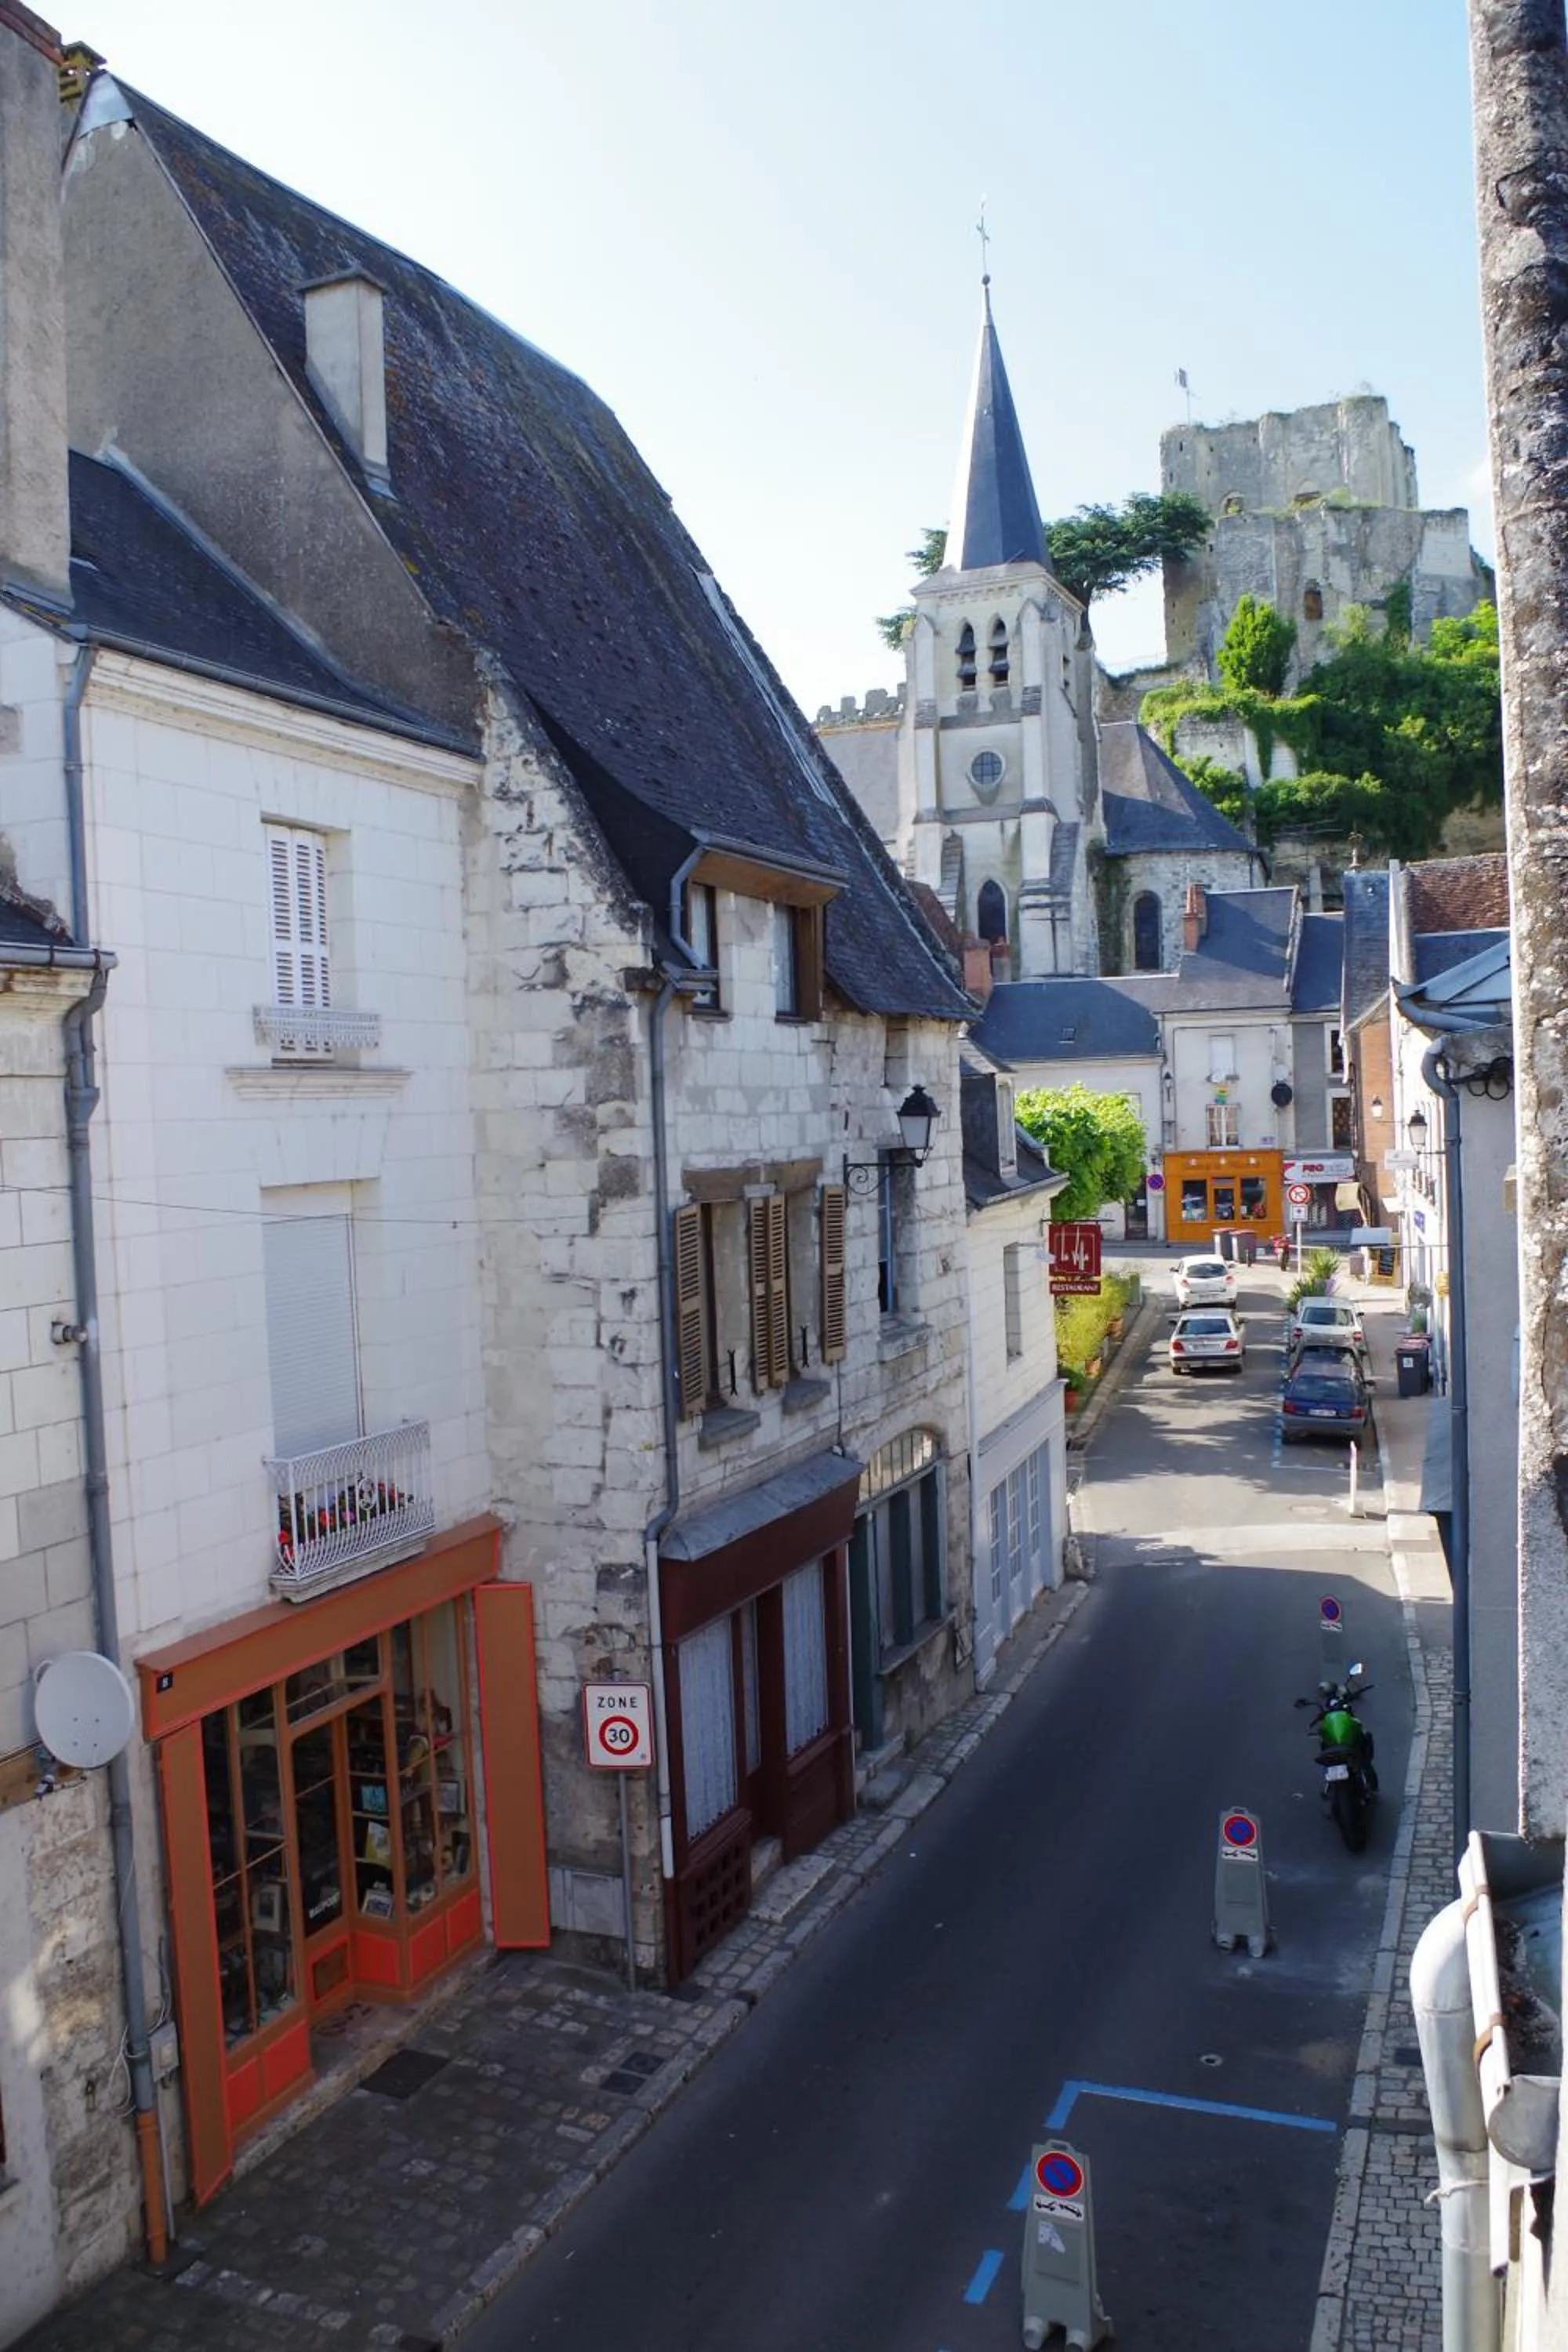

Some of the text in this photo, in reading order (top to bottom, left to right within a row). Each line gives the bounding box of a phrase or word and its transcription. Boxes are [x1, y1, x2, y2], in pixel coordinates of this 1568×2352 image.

[1051, 1283, 1098, 1292] RESTAURANT
[597, 1696, 638, 1708] ZONE
[608, 1728, 630, 1744] 30
